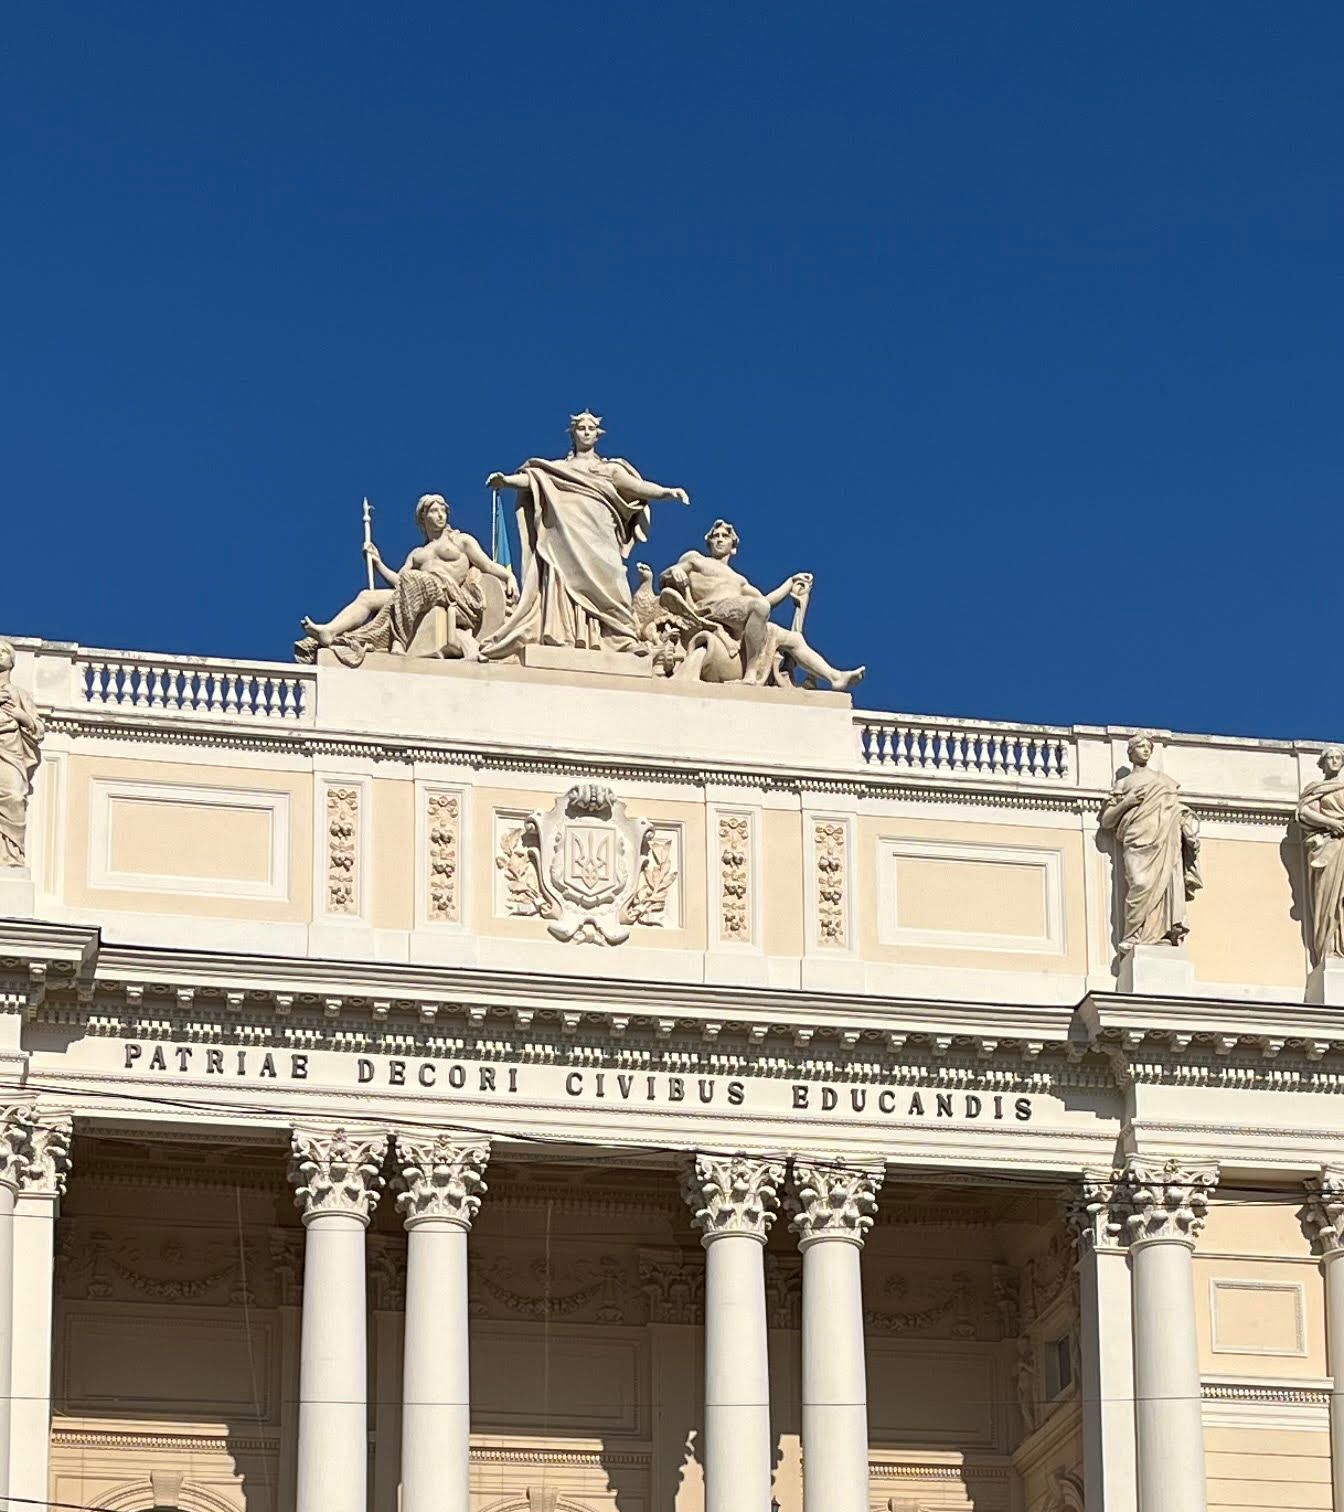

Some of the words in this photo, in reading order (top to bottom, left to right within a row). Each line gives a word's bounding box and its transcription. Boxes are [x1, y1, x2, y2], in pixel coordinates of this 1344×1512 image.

[124, 1043, 309, 1080] PATRIAE
[357, 1057, 518, 1093] DECORI
[565, 1071, 745, 1105] CIVIBUS
[792, 1084, 1032, 1121] EDUCANDIS
